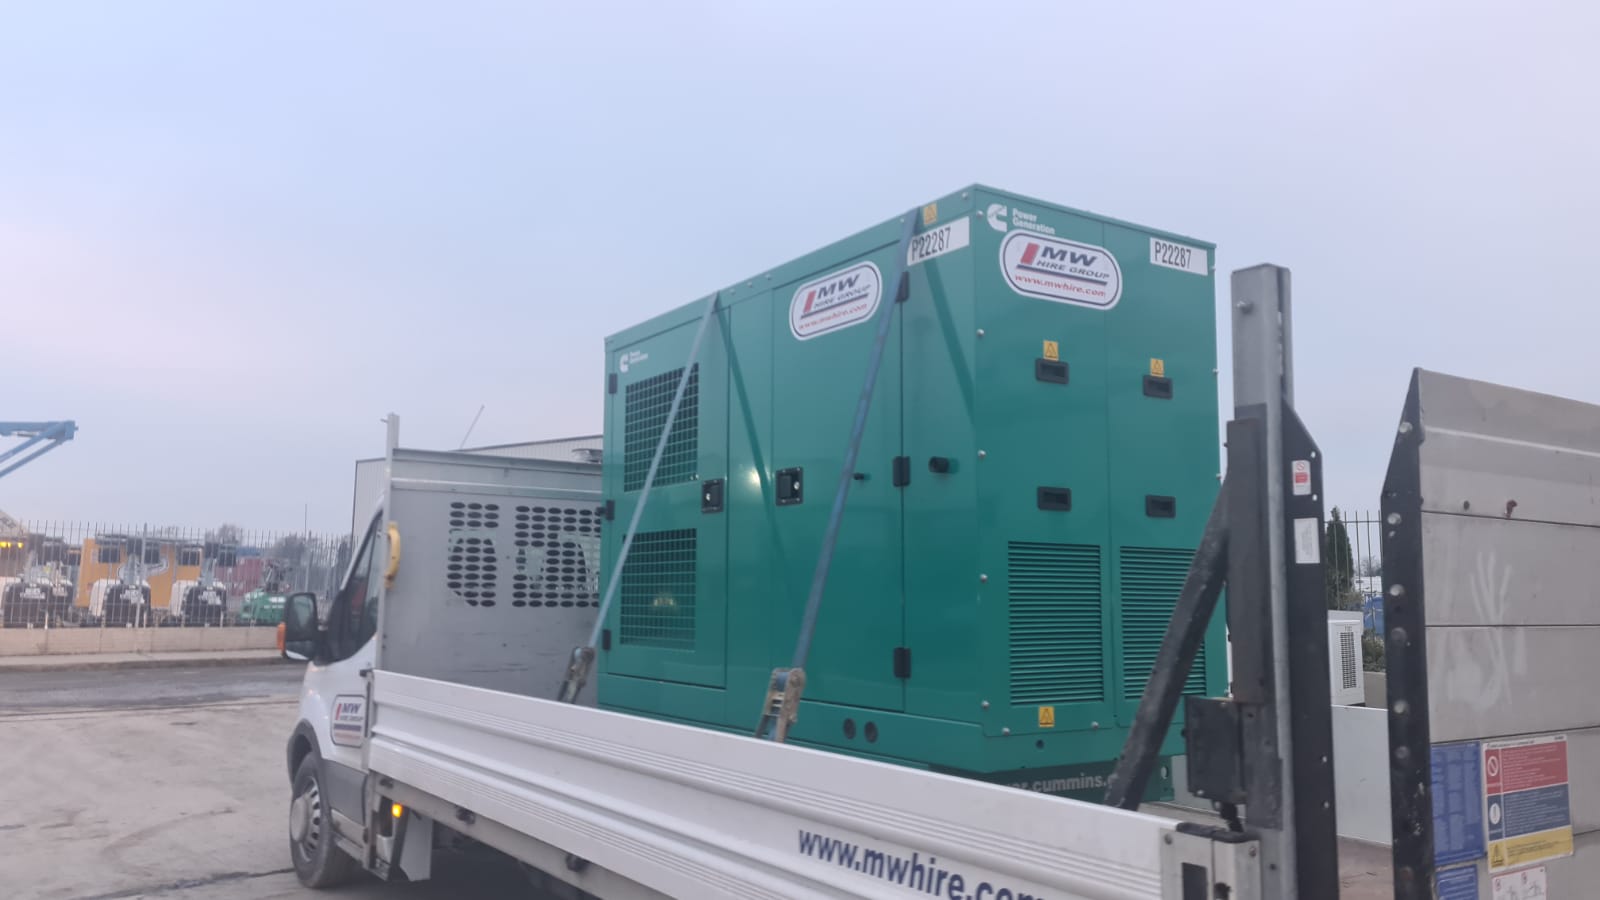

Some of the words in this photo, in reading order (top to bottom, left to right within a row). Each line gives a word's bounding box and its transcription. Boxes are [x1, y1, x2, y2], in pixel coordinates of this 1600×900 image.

[1012, 208, 1037, 222] Power
[1012, 217, 1056, 235] Generation
[911, 226, 951, 261] P22287
[1041, 246, 1097, 267] MW
[1154, 241, 1192, 269] P22287
[1036, 260, 1066, 272] HIRE
[1069, 266, 1110, 280] GROUP
[818, 274, 860, 299] MW
[1015, 275, 1105, 297] www.mwhire.com
[342, 703, 362, 714] MW
